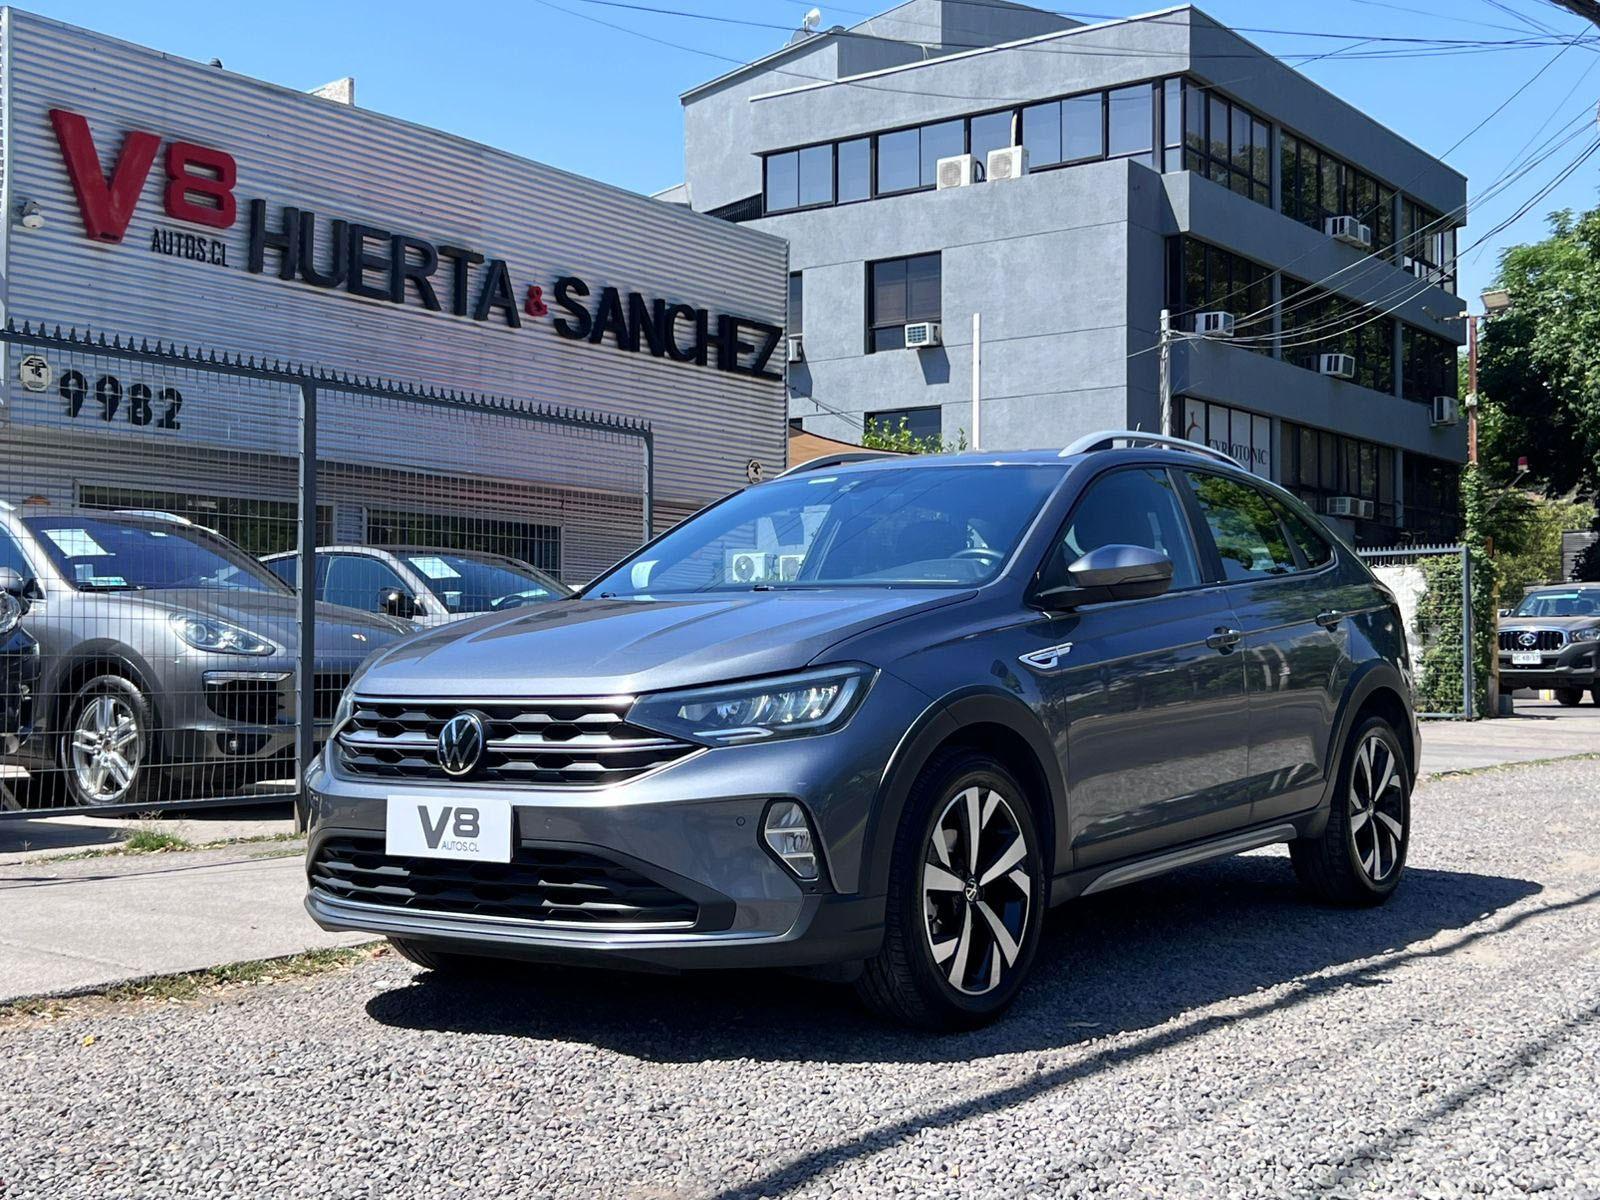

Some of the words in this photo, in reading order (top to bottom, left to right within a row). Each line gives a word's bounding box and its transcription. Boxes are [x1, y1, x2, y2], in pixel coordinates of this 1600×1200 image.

[49, 108, 237, 243] V8
[151, 227, 229, 267] AUTOS.CL
[249, 198, 521, 328] HUERTA
[525, 285, 548, 317] &
[553, 277, 784, 380] SANCHEZ
[60, 370, 183, 430] 9982
[417, 805, 480, 849] V8
[441, 840, 480, 852] AUTOS.CL
